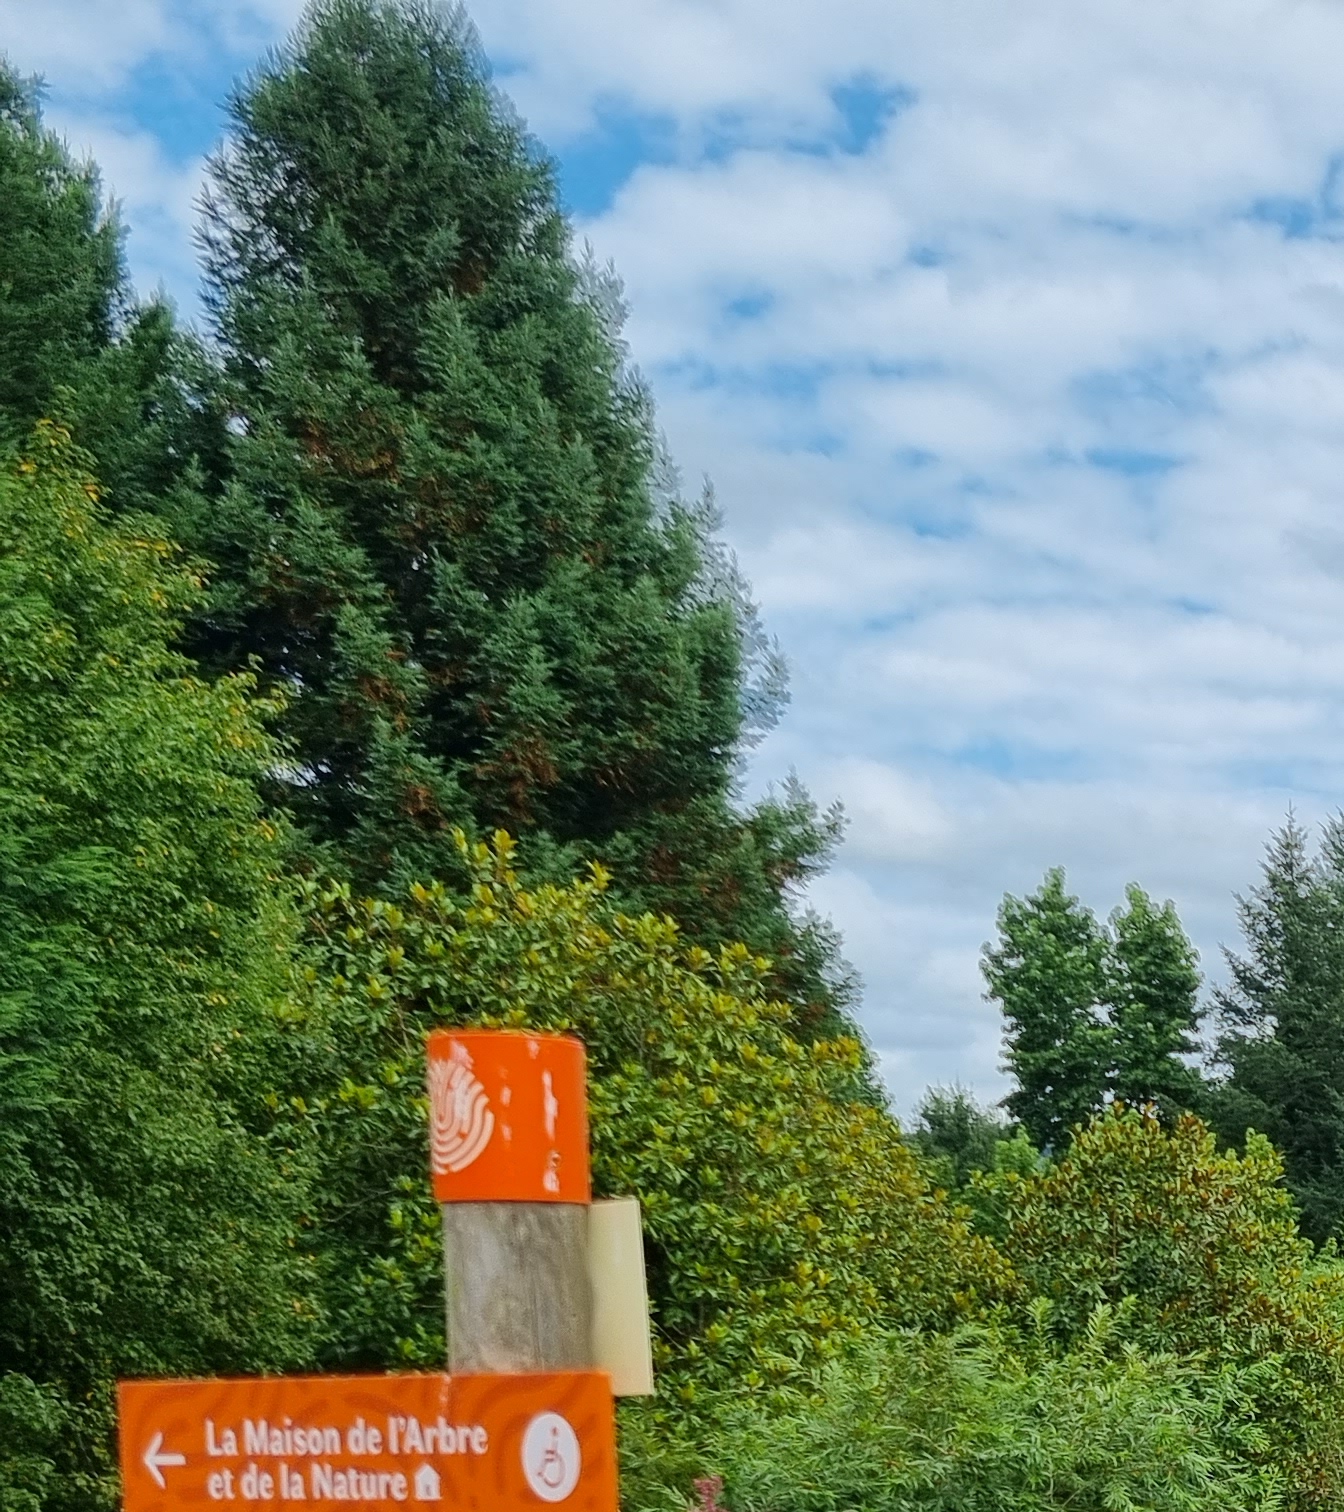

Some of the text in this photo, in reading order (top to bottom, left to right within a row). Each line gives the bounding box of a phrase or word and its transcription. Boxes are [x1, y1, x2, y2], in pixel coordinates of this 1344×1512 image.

[205, 1419, 238, 1457] La
[243, 1417, 341, 1457] Maison
[346, 1417, 383, 1455] de
[207, 1462, 408, 1501] et de la Nature
